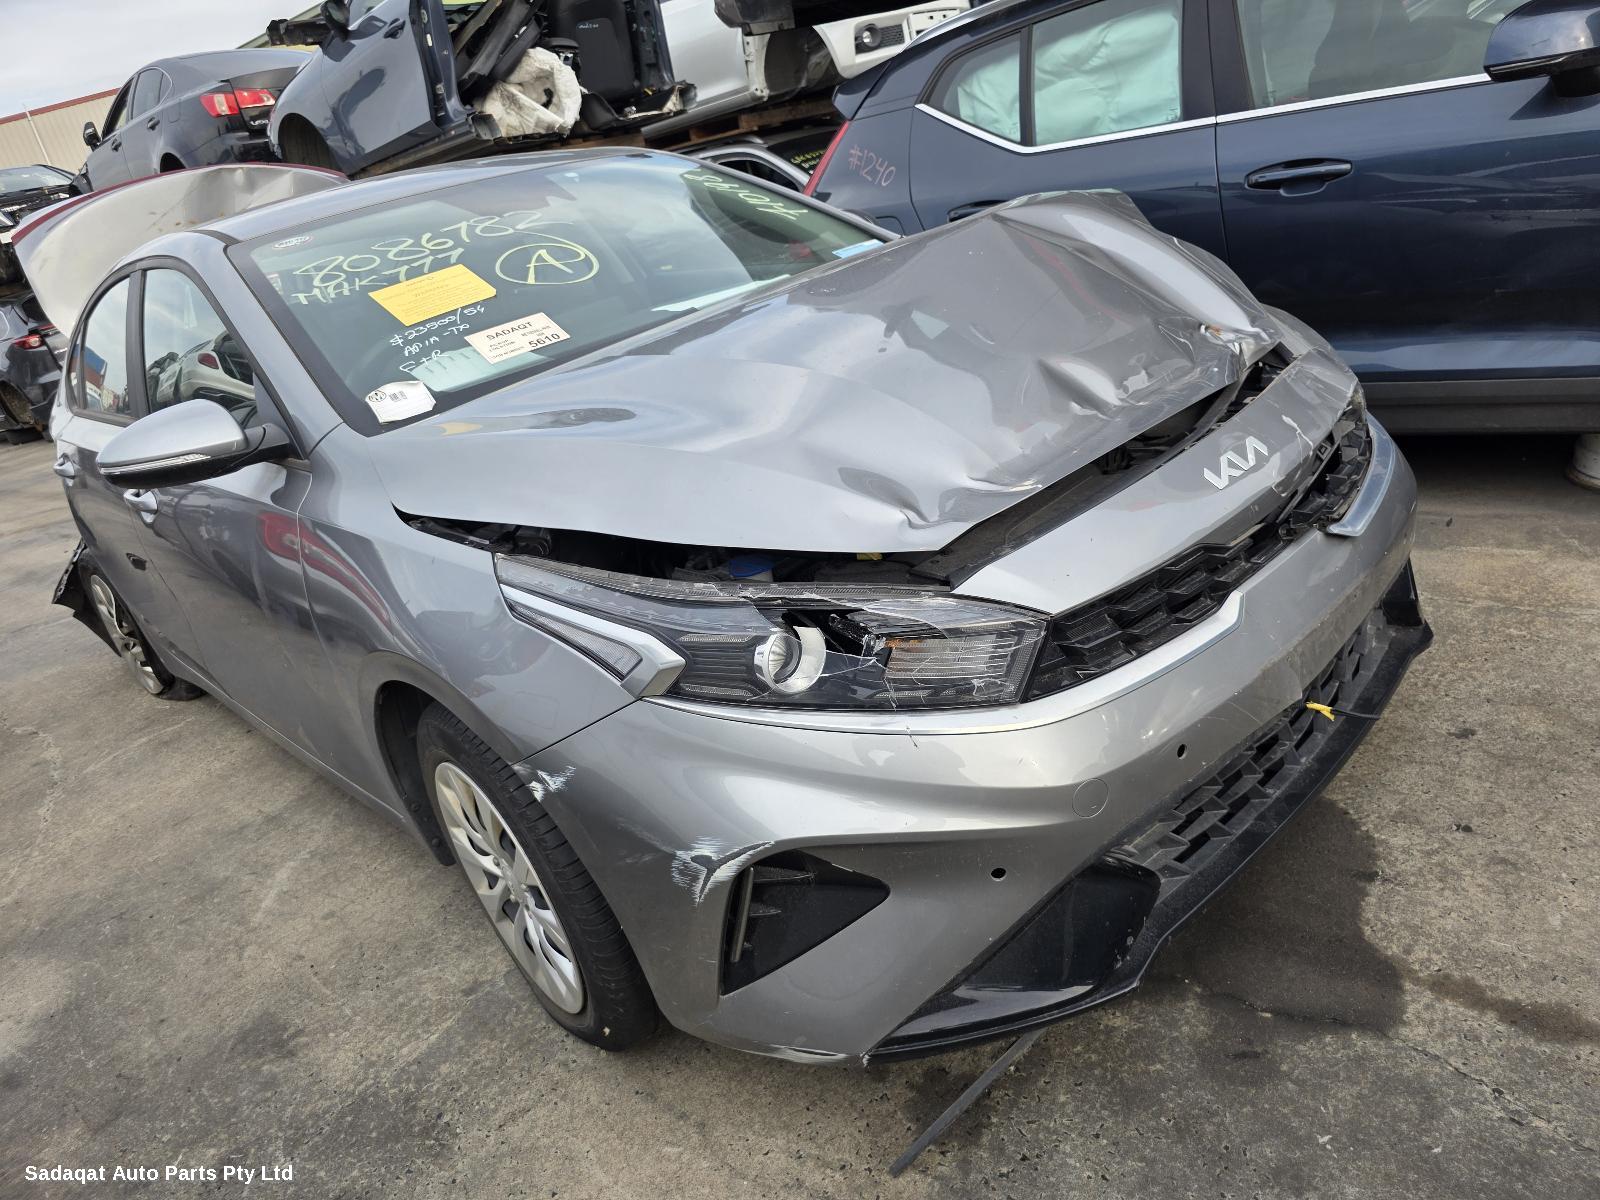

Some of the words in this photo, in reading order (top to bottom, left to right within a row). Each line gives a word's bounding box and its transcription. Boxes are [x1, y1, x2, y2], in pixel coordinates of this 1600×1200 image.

[848, 144, 896, 186] #1240
[293, 210, 574, 286] 8086782
[528, 333, 561, 348] 5610
